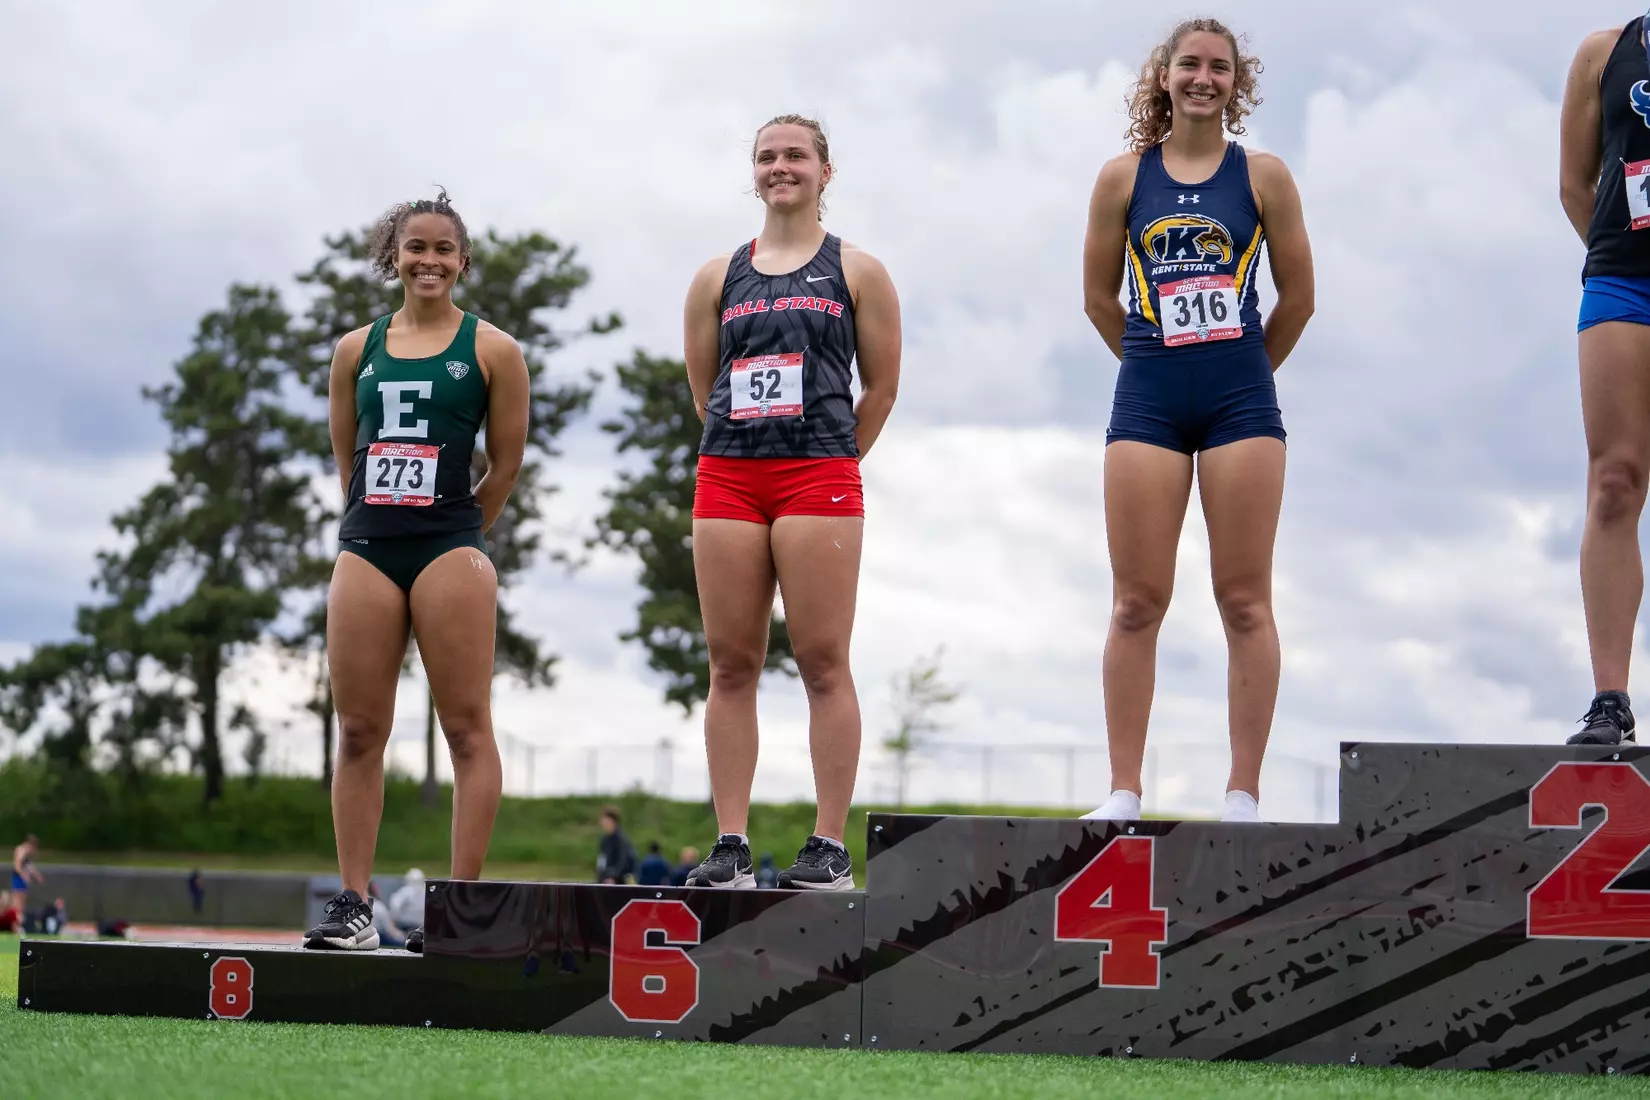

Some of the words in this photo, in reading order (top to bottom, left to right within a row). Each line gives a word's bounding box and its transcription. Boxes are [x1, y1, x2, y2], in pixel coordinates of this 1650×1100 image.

[1152, 264, 1179, 275] KENT
[1182, 264, 1216, 272] STATE
[722, 299, 769, 325] BALL
[773, 297, 844, 318] STATE
[1173, 290, 1227, 327] 316
[750, 369, 782, 401] 52
[377, 381, 433, 439] E
[376, 458, 423, 489] 273
[1527, 761, 1650, 939] 2
[1054, 835, 1168, 989] 4
[609, 899, 701, 1023] 6
[209, 956, 254, 1019] 8
